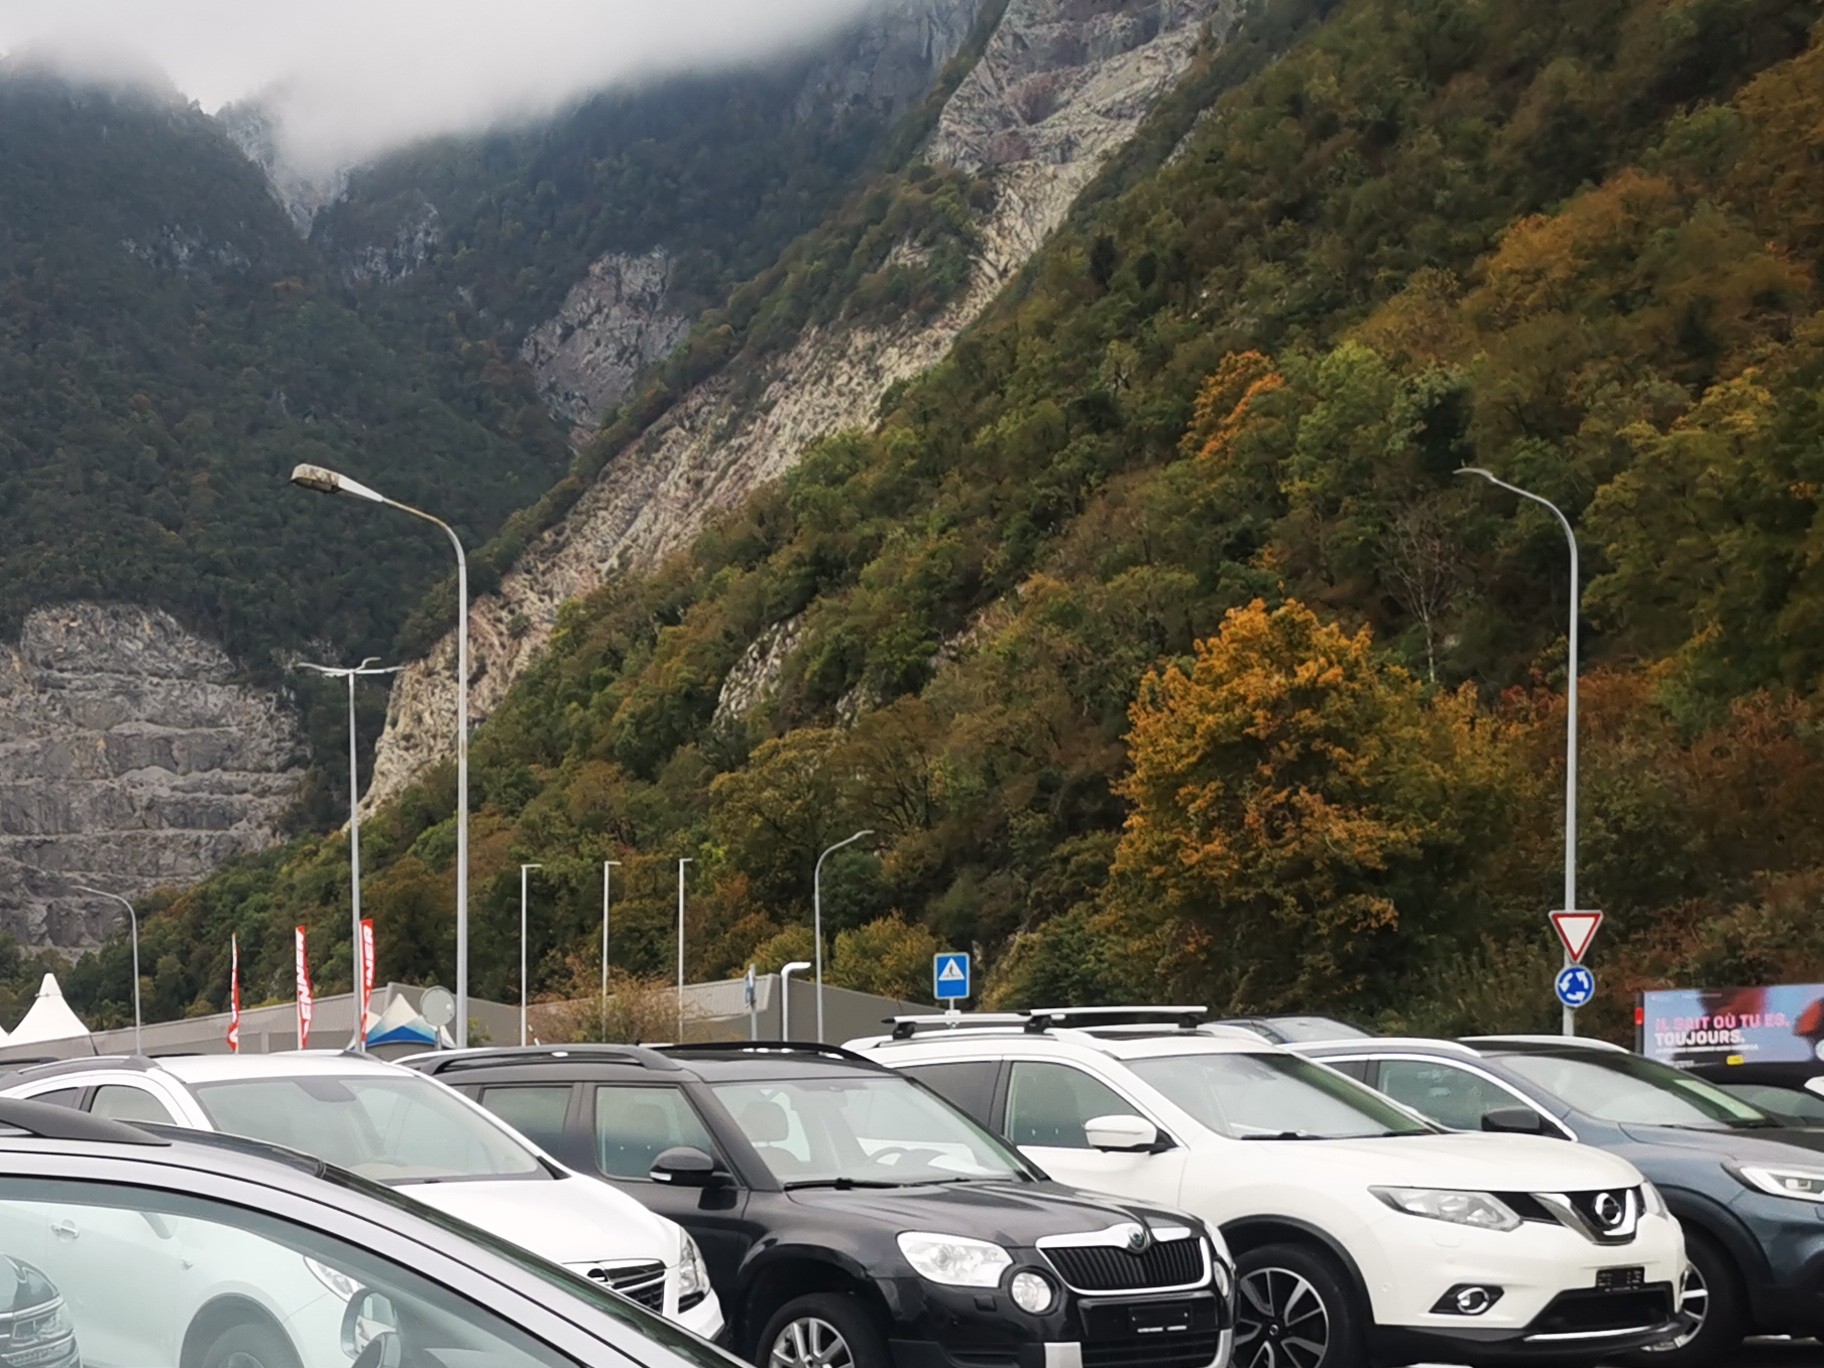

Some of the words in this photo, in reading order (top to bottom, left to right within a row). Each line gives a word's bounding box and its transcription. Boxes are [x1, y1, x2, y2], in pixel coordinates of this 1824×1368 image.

[1673, 1014, 1710, 1031] SAIT
[1713, 1012, 1737, 1030] OÙ
[1739, 1013, 1761, 1028] TU
[1654, 1029, 1746, 1047] TOUJOURS.
